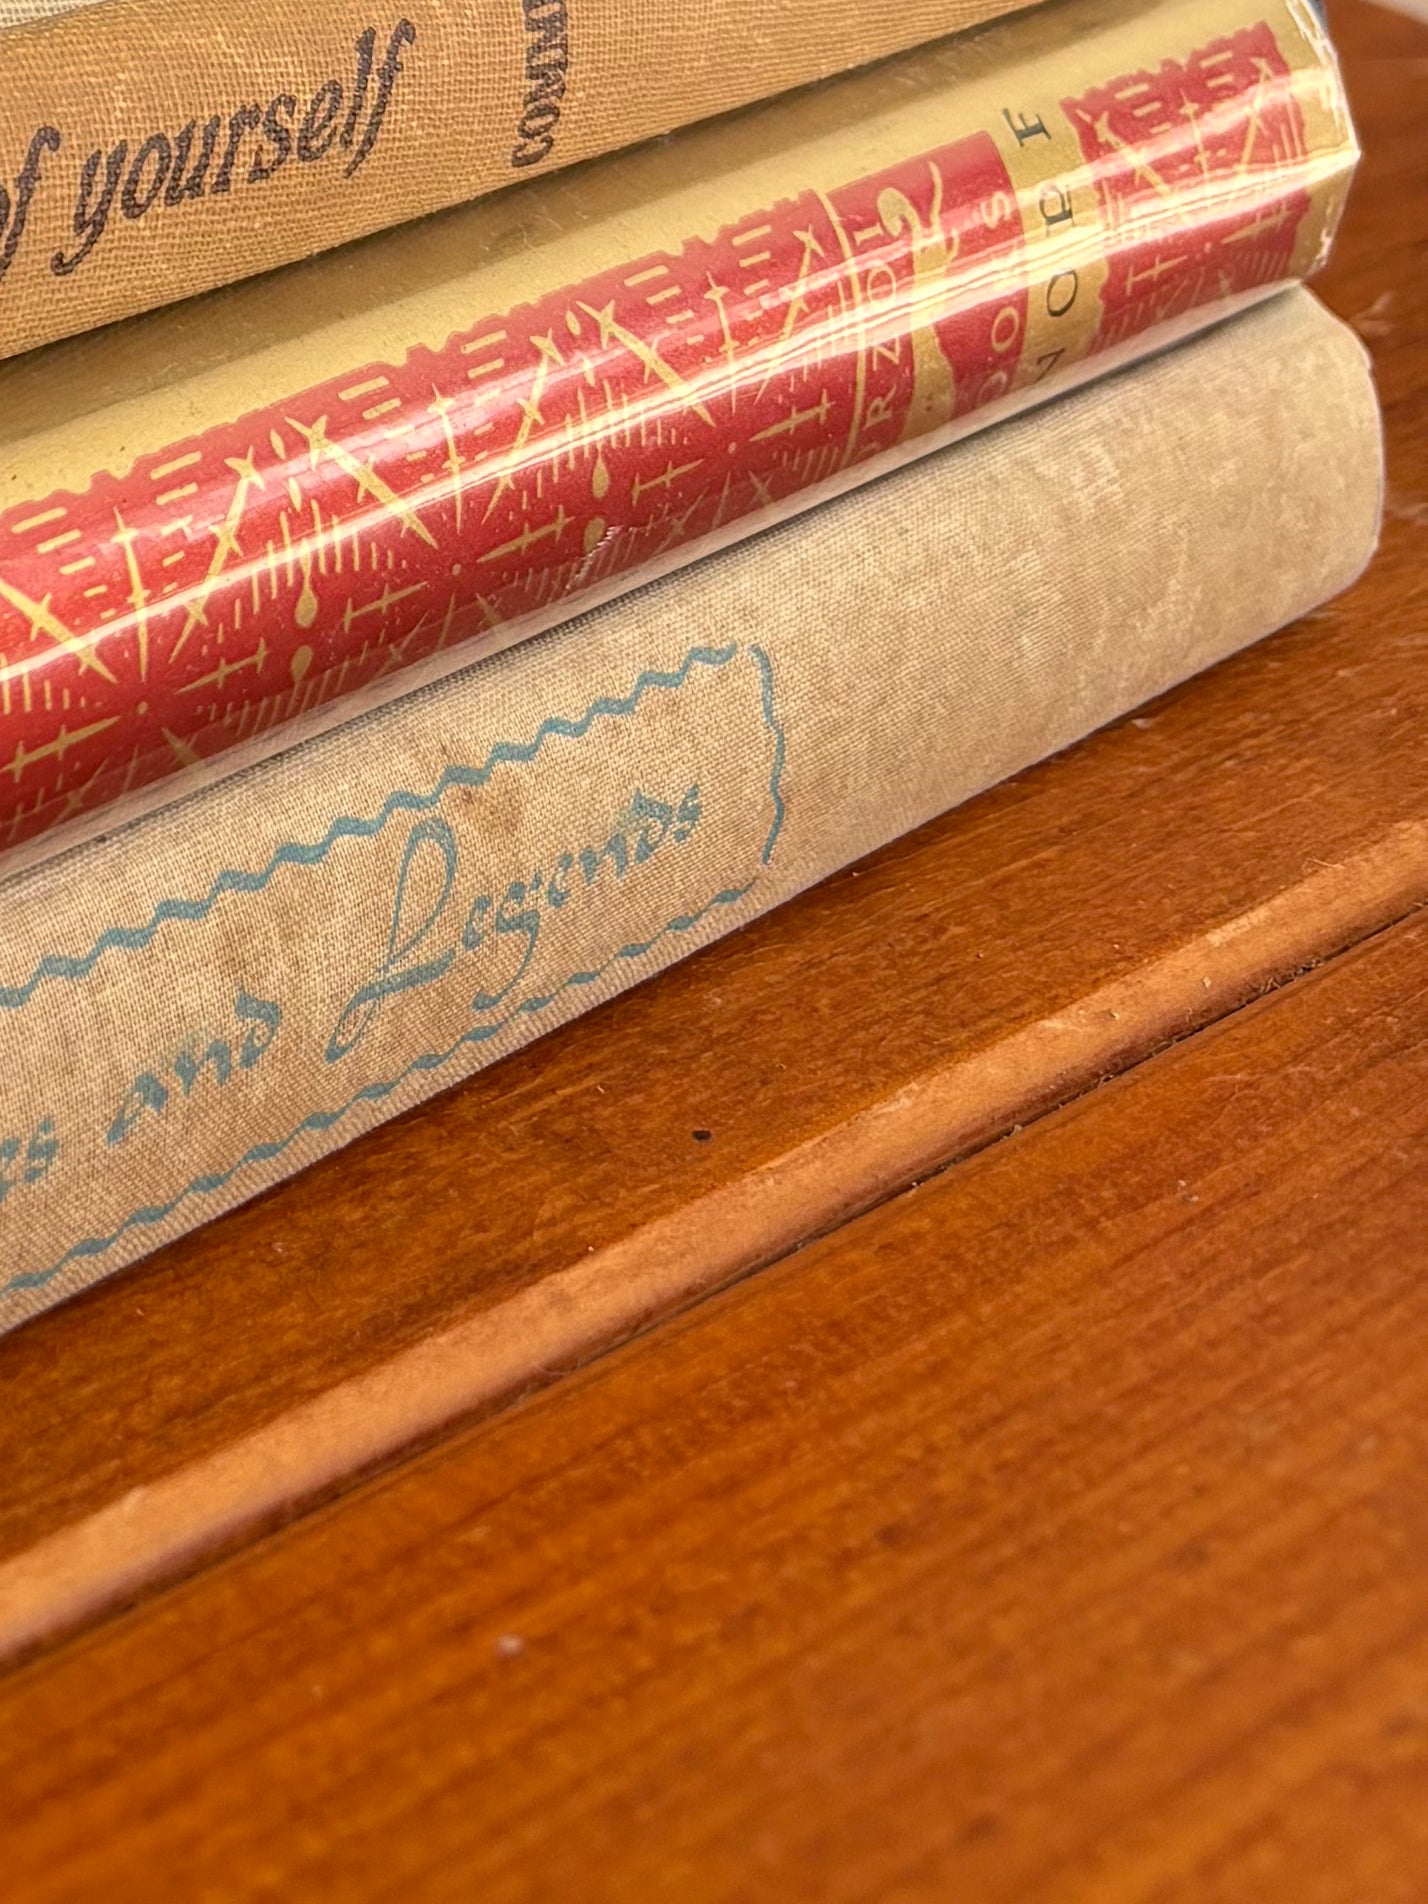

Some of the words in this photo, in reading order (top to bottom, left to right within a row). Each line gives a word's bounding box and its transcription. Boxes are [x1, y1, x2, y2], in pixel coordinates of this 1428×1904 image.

[49, 18, 418, 278] yourself
[104, 989, 280, 1144] and
[325, 784, 702, 1063] Legends
